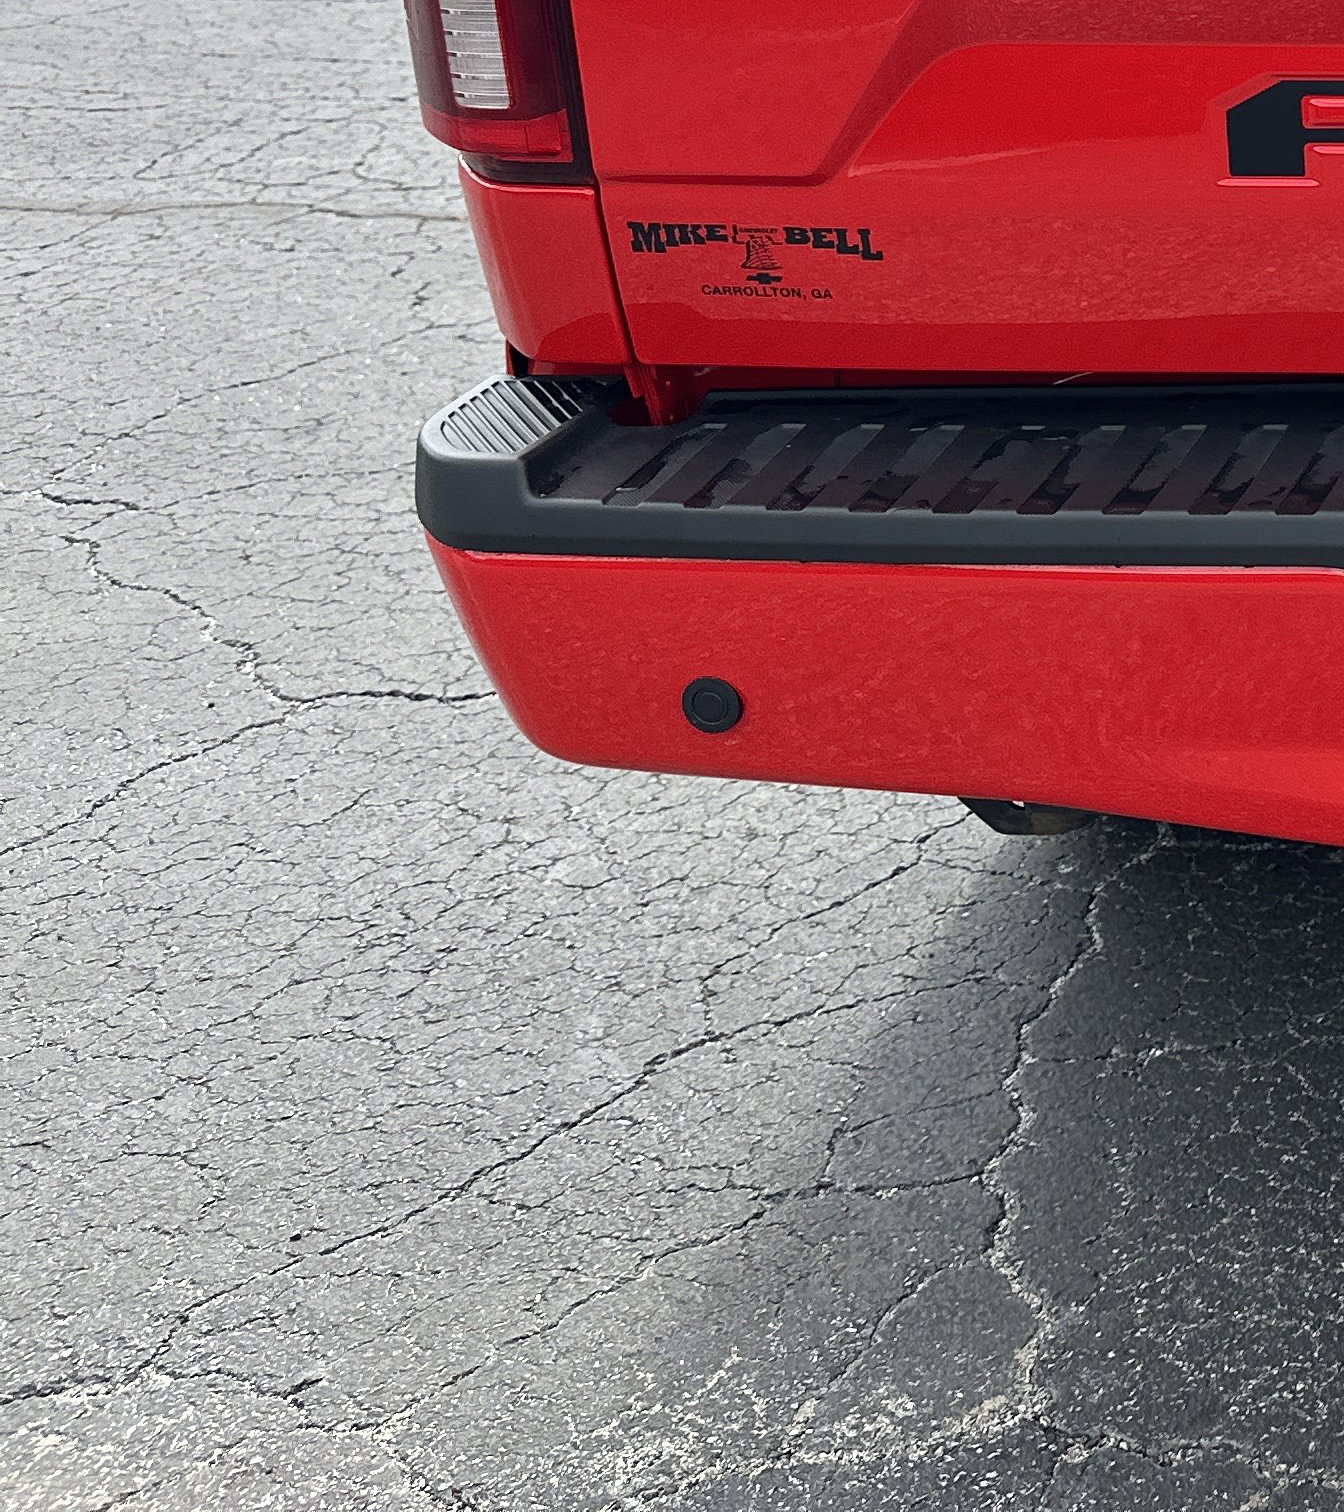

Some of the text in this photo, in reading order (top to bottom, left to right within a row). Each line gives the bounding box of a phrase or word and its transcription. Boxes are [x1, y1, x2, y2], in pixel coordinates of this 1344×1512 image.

[627, 221, 884, 261] MIKE BELL
[702, 284, 833, 300] CARROLLTON, GA
